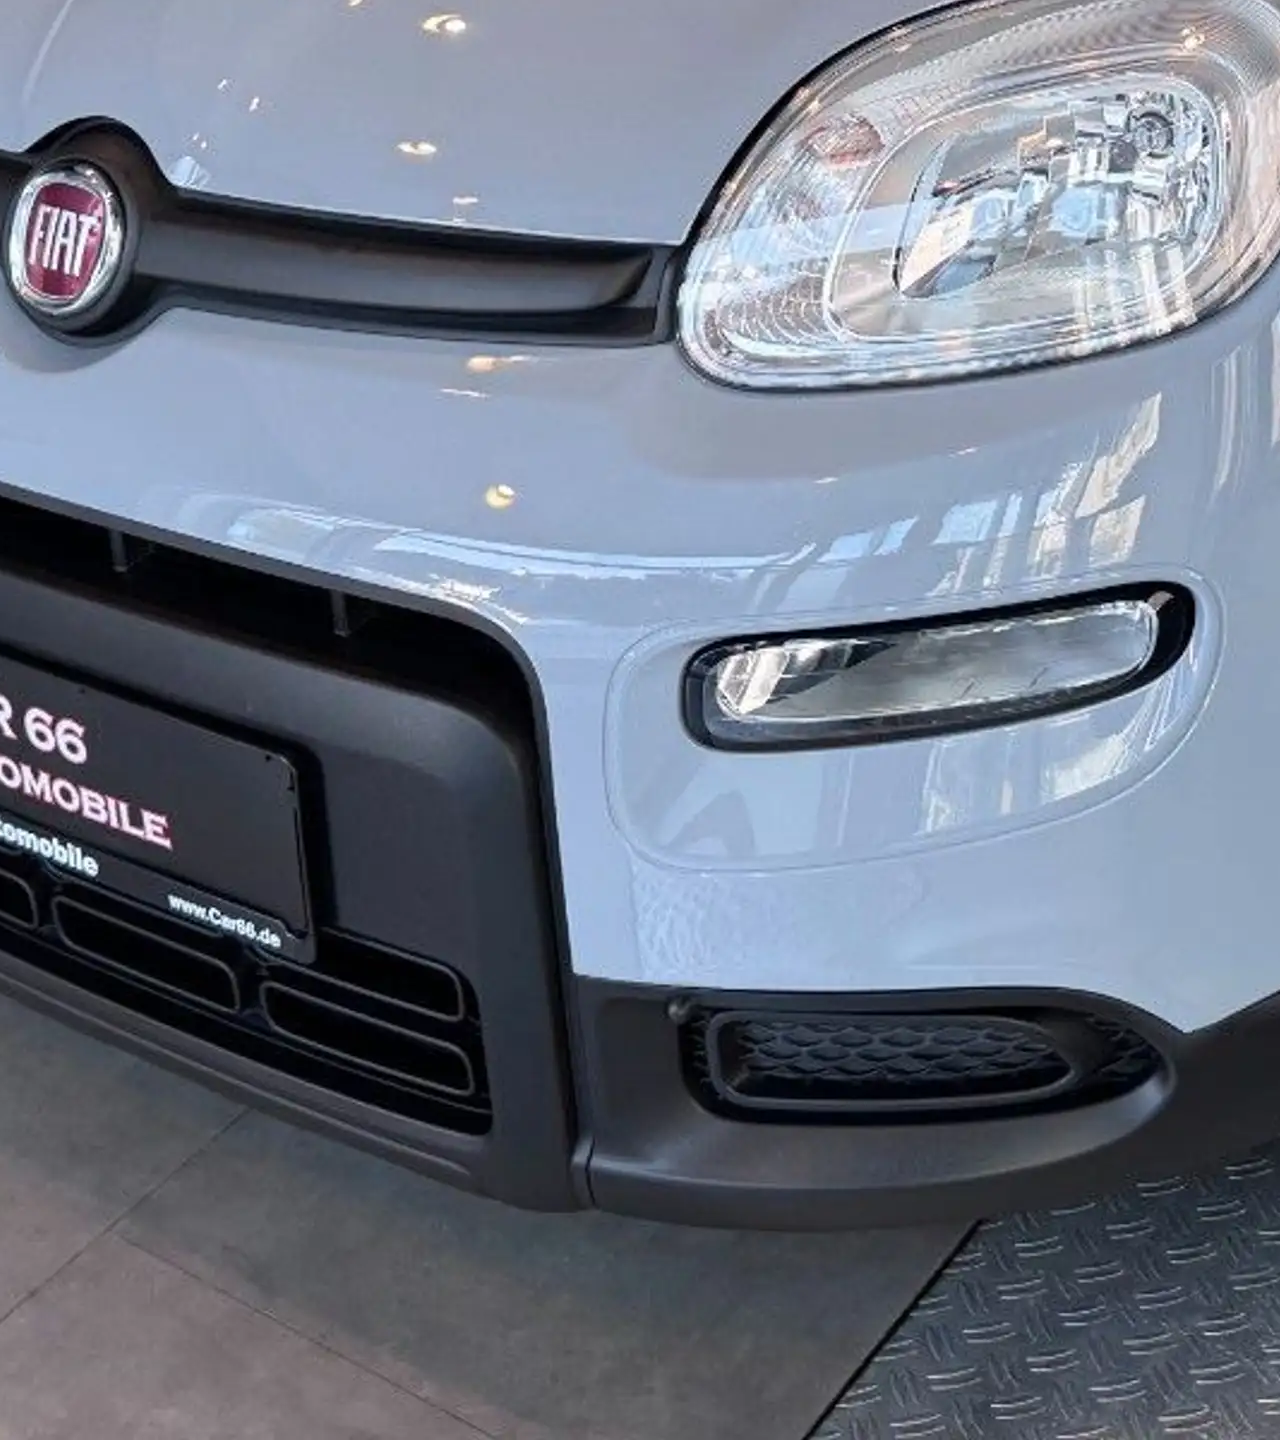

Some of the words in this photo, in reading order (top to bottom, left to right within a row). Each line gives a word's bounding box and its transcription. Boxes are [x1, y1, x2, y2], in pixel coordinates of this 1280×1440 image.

[29, 203, 99, 278] FIAT
[24, 707, 88, 764] 66
[167, 893, 281, 949] www.Car66.de
